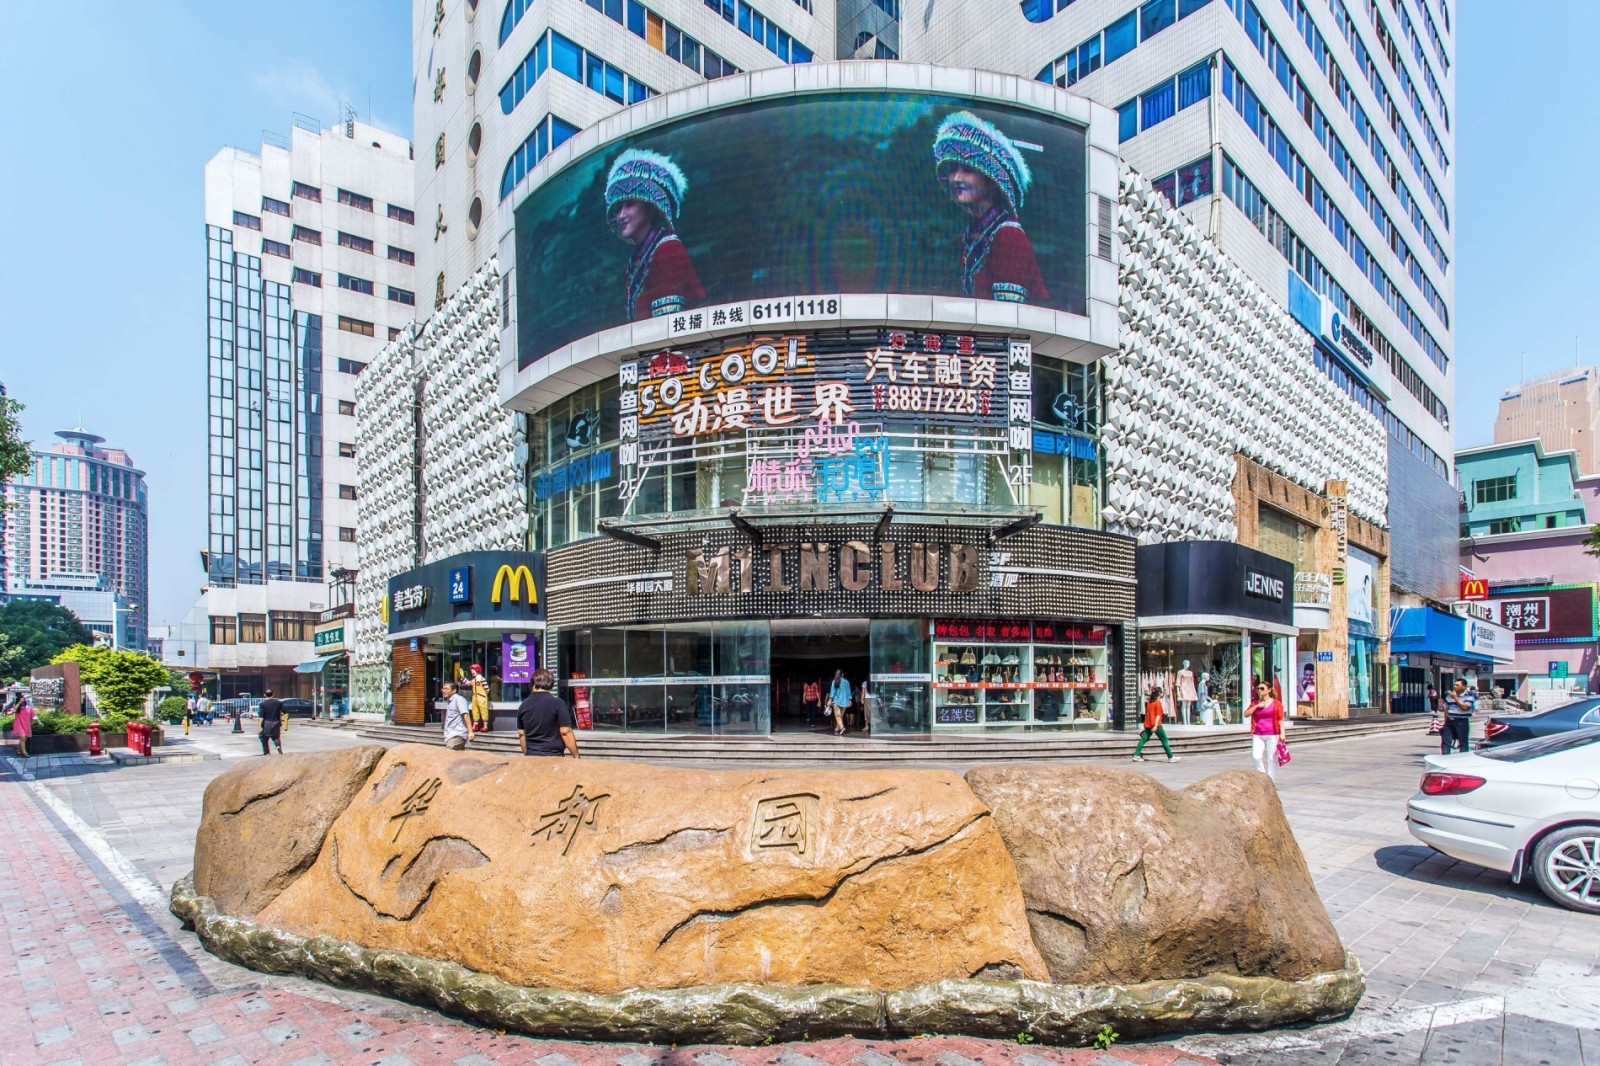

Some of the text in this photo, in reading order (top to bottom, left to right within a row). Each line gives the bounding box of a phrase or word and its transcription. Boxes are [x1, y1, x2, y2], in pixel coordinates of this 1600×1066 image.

[673, 299, 838, 332] 投播 热线 61111118
[640, 337, 809, 418] SO COOL
[864, 348, 998, 390] 汽车融资
[671, 383, 856, 436] 动漫世界
[888, 385, 977, 414] 88877225
[1009, 342, 1032, 450] 网鱼网咖
[620, 361, 639, 465] 网鱼网咖
[1009, 465, 1033, 486] 2F
[988, 552, 1011, 566] 3F
[452, 582, 464, 595] 24
[989, 573, 1019, 588] 酒吧
[1246, 571, 1284, 600] JENNS
[394, 585, 424, 612] 麦当劳
[1505, 603, 1539, 617] 潮州
[1505, 616, 1540, 629] 打冷
[940, 708, 977, 722] 名牌包
